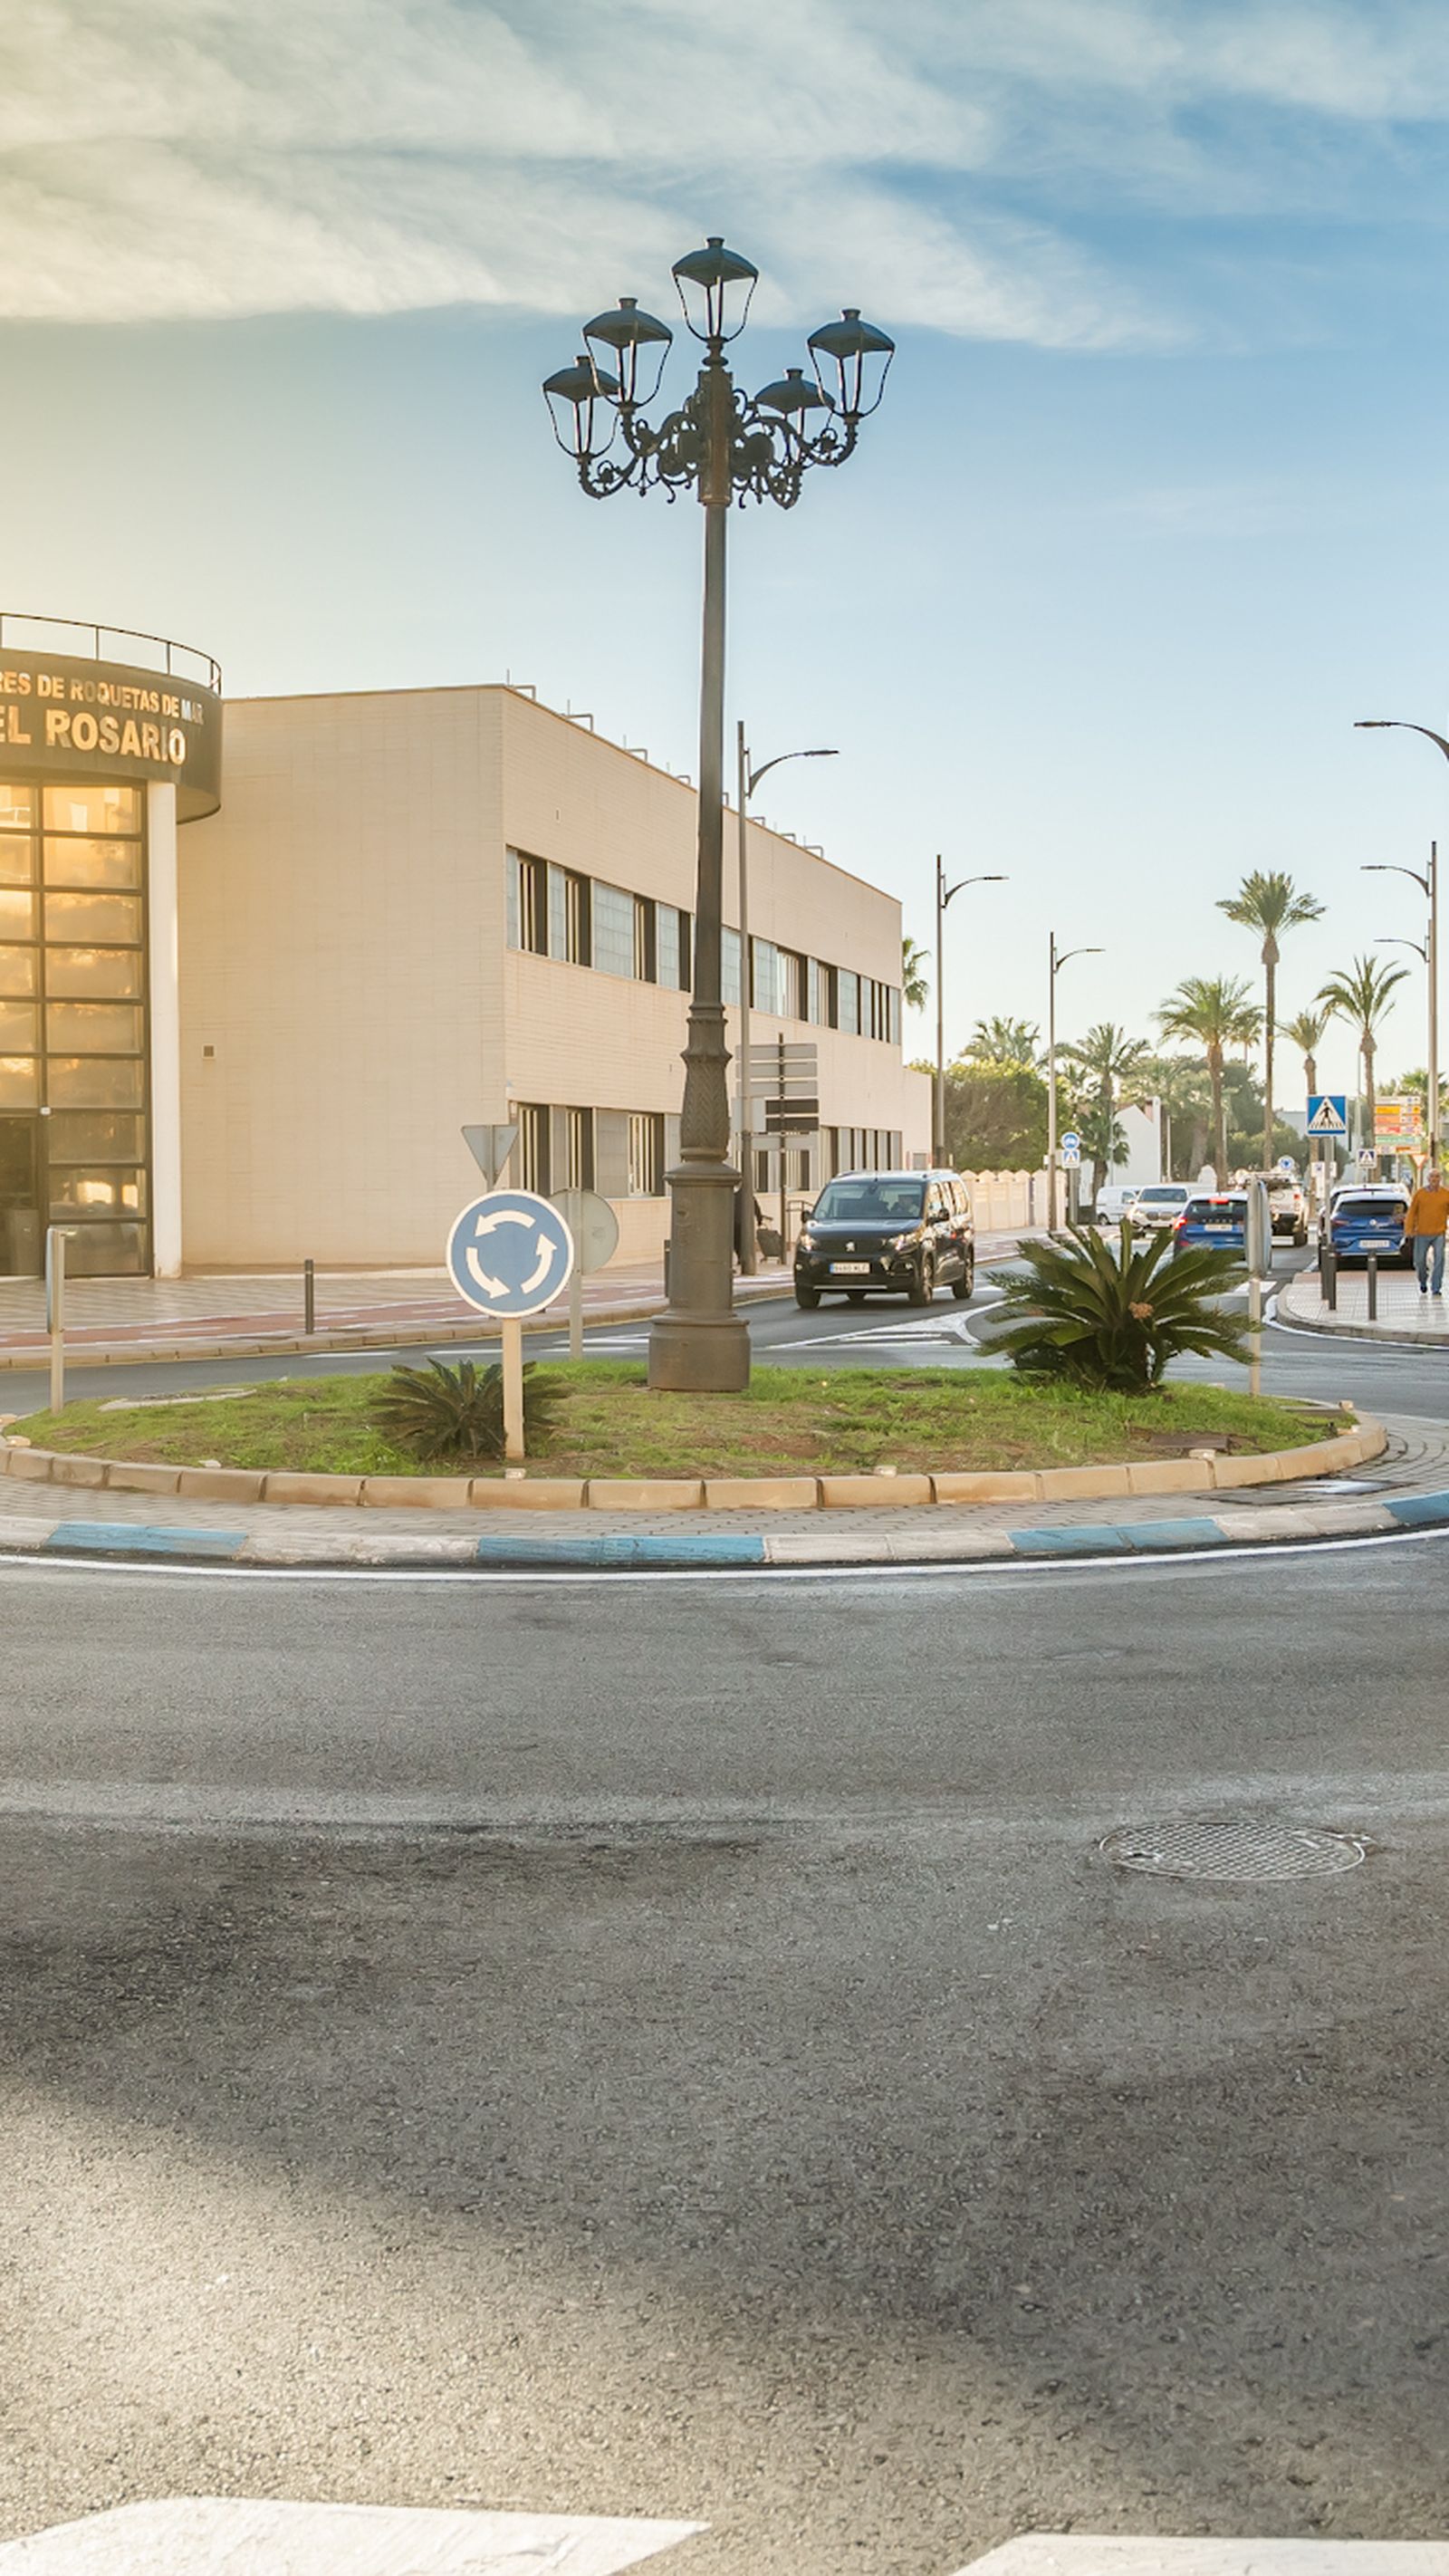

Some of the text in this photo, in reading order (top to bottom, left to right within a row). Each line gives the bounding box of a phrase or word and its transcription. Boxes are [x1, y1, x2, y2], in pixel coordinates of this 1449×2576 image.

[37, 675, 64, 699] DE
[71, 678, 159, 714] ROQUETAS
[162, 694, 179, 718] DE
[182, 698, 204, 725] MAR
[0, 706, 186, 765] L ROSARIO
